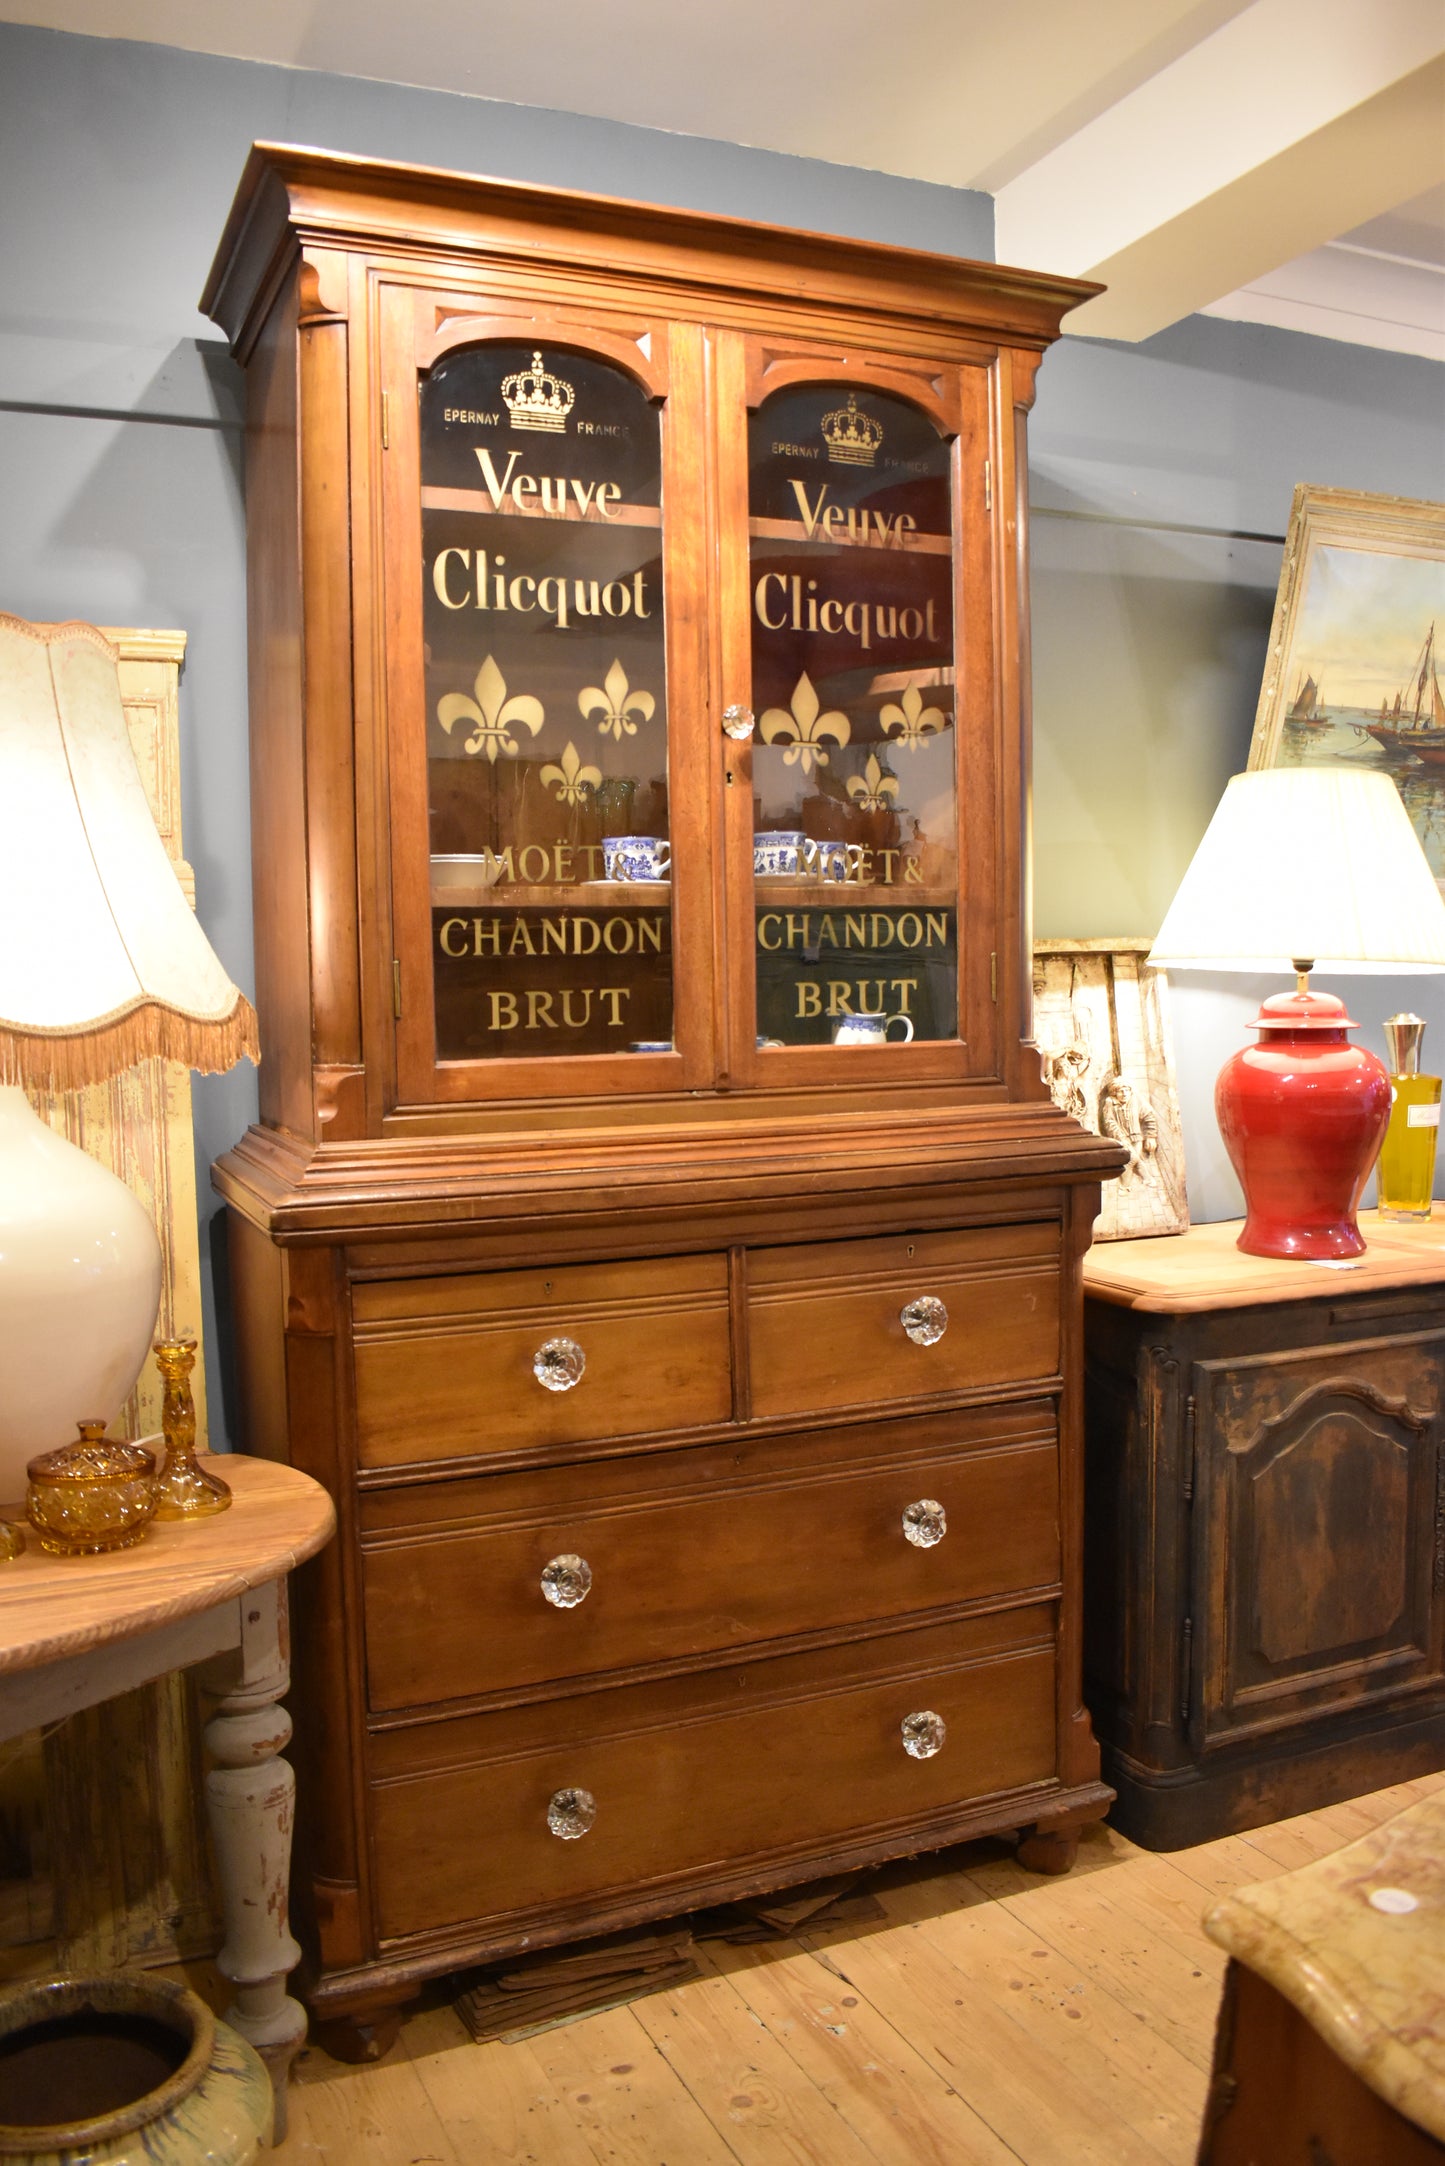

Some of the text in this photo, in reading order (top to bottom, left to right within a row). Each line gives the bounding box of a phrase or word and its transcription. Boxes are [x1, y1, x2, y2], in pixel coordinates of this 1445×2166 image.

[444, 408, 500, 426] EPERNAY
[771, 441, 819, 460] EPERNAY
[474, 448, 622, 519] Veuve
[787, 479, 917, 546] Veuve
[432, 548, 651, 629] Clicquot
[754, 573, 940, 649] Clicquot
[482, 839, 636, 883] MOËT &
[794, 843, 925, 885] MOËT &
[440, 916, 663, 957] CHANDON
[757, 912, 948, 950] CHANDON
[486, 987, 630, 1030] BRUT
[794, 979, 918, 1018] BRUT
